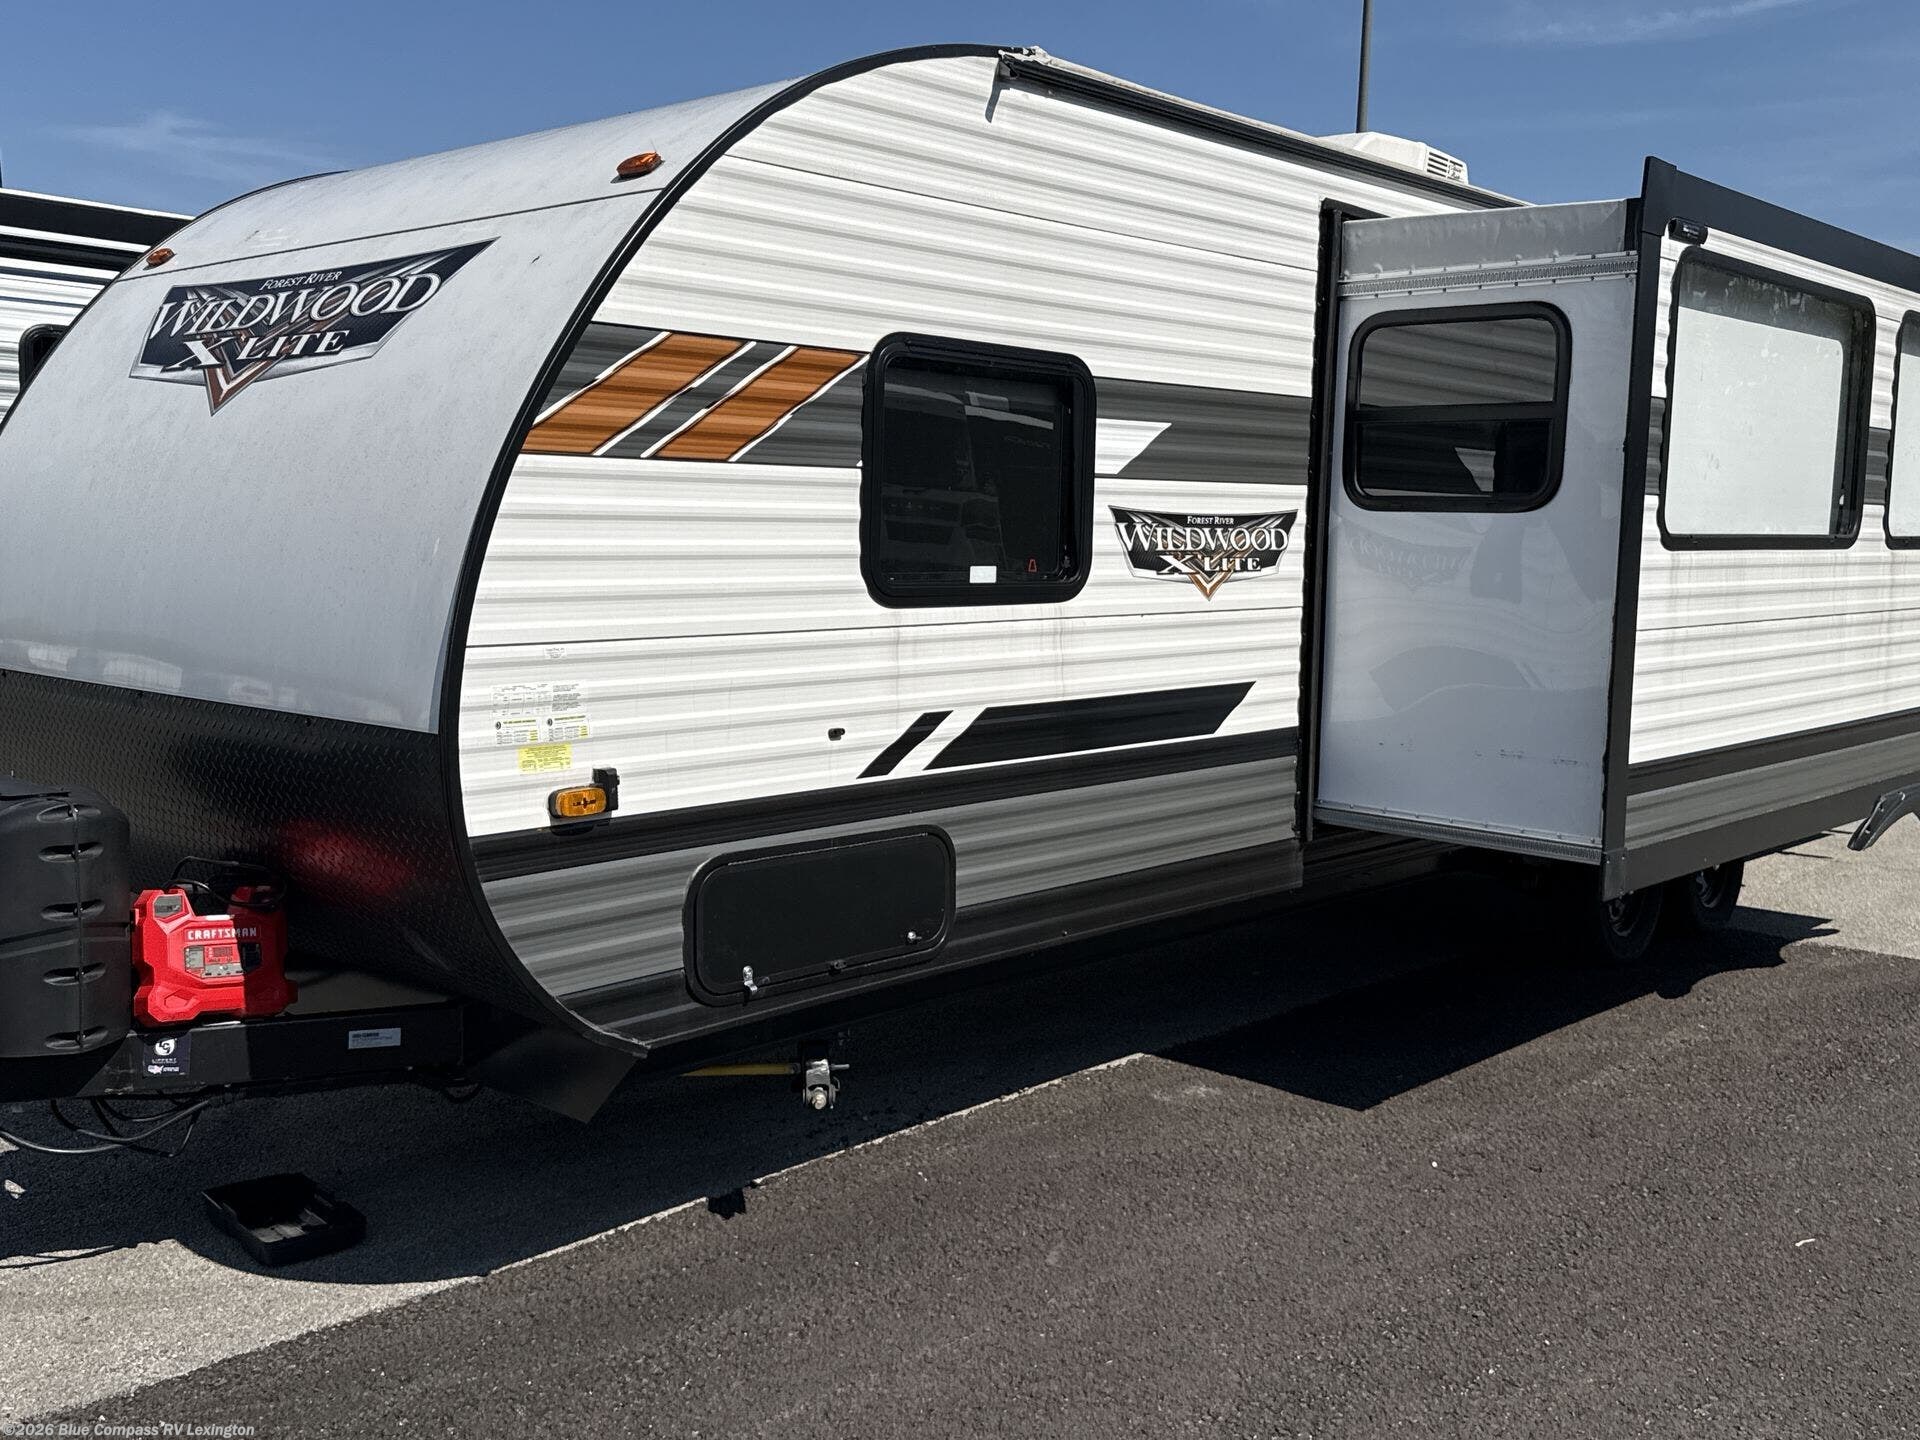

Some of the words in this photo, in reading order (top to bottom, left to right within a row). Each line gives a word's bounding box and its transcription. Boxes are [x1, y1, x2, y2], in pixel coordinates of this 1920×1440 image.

[259, 276, 307, 290] FOREST
[303, 271, 342, 284] RIVER
[149, 272, 442, 339] WILDWOOD
[1187, 515, 1213, 524] FOREST
[1214, 516, 1234, 524] RIVER
[1115, 522, 1288, 551] WILDWOOD
[187, 927, 257, 940] CRAFTSMAN
